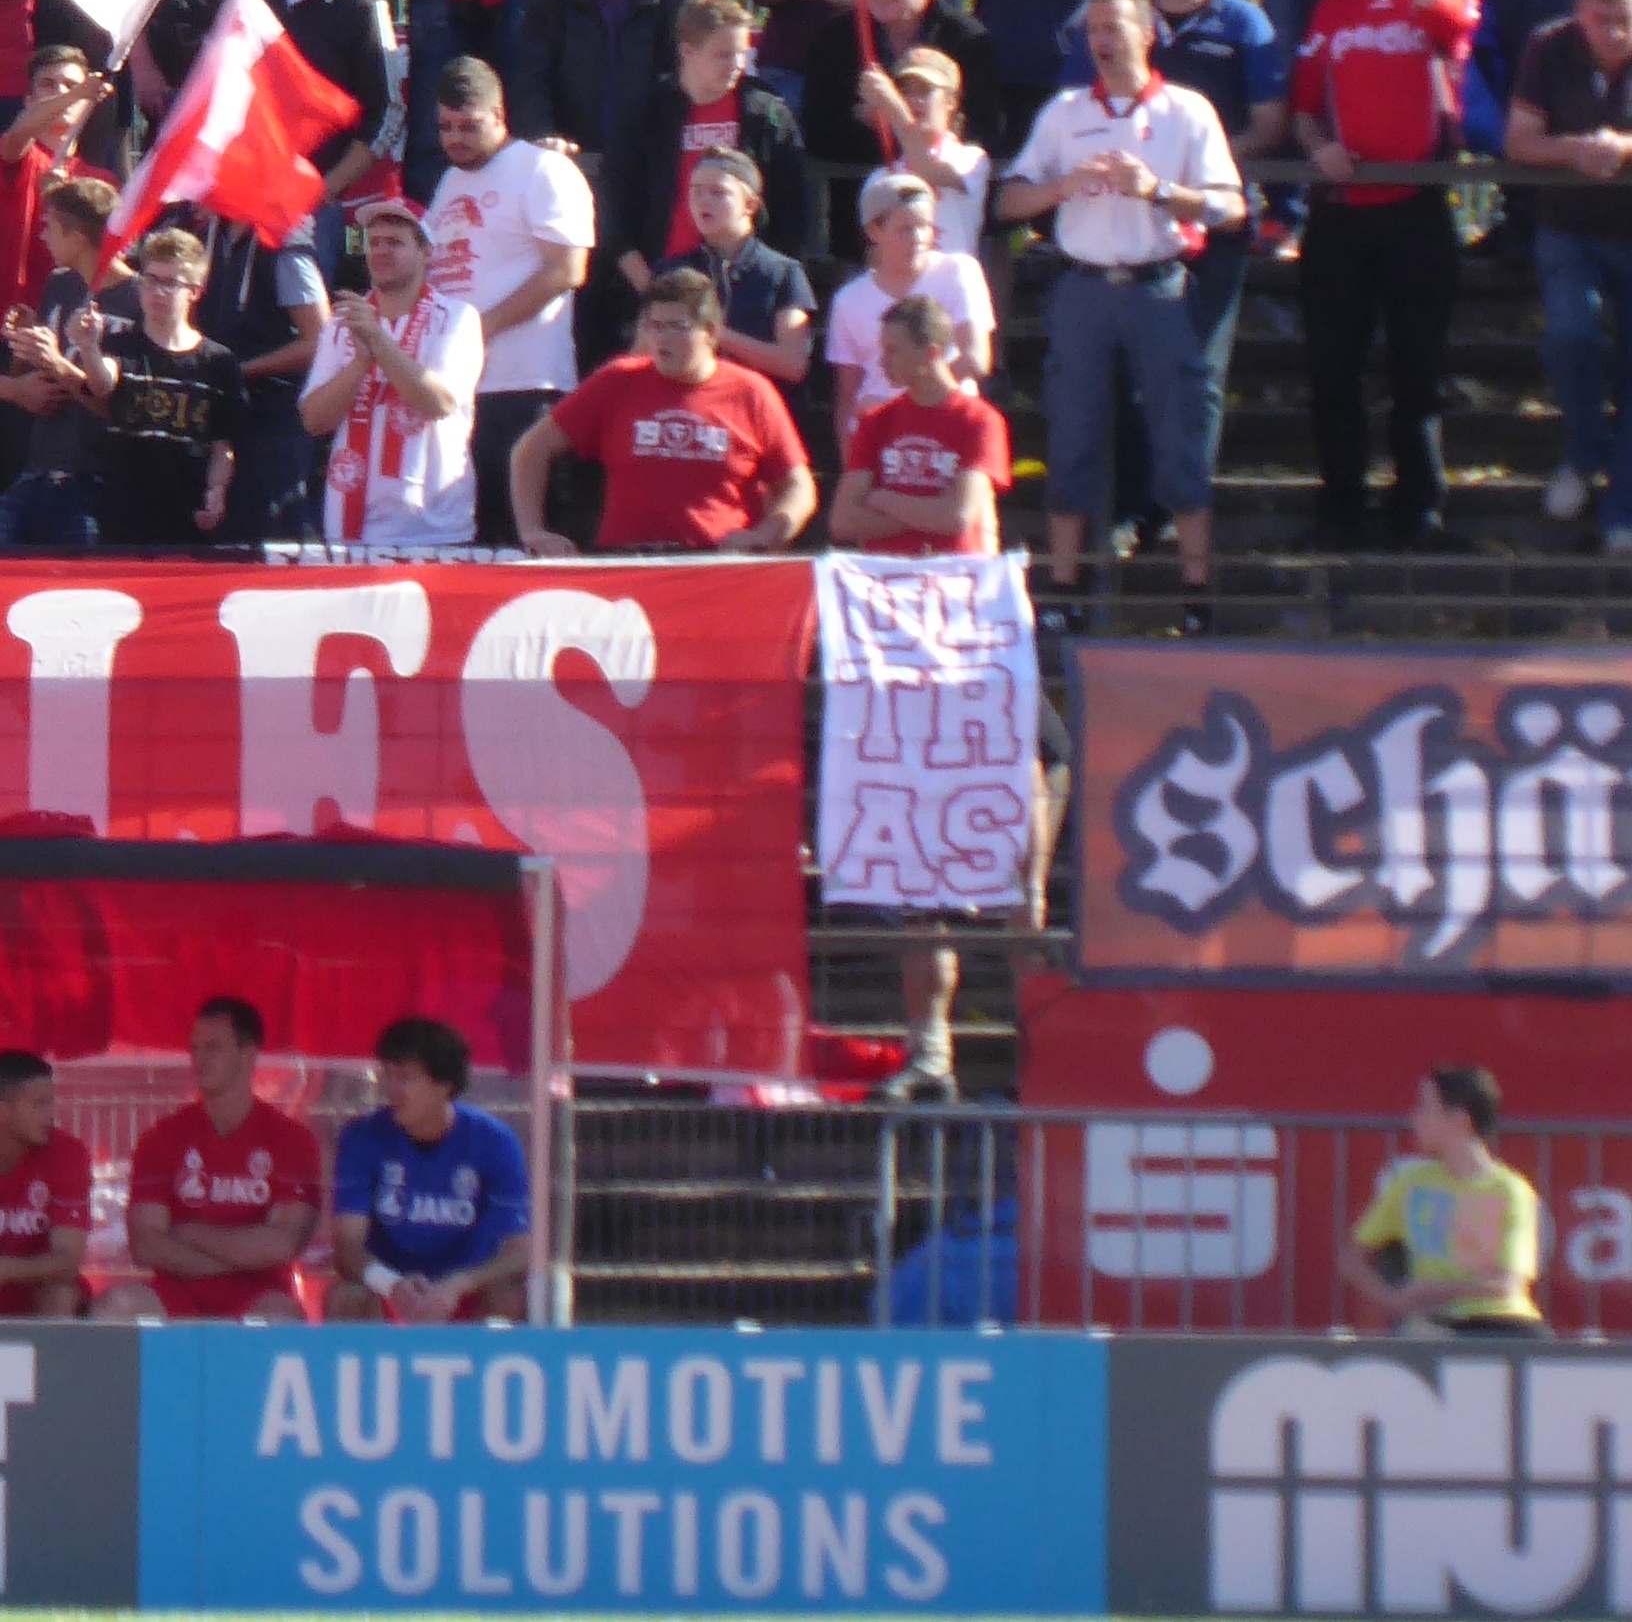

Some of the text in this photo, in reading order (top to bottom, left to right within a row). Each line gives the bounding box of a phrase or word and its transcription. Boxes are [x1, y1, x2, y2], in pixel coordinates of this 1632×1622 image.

[836, 659, 1023, 769] TR
[824, 782, 1027, 896] AS
[255, 1354, 995, 1467] AUTOMOTIVE
[299, 1487, 948, 1600] SOLUTIONS
